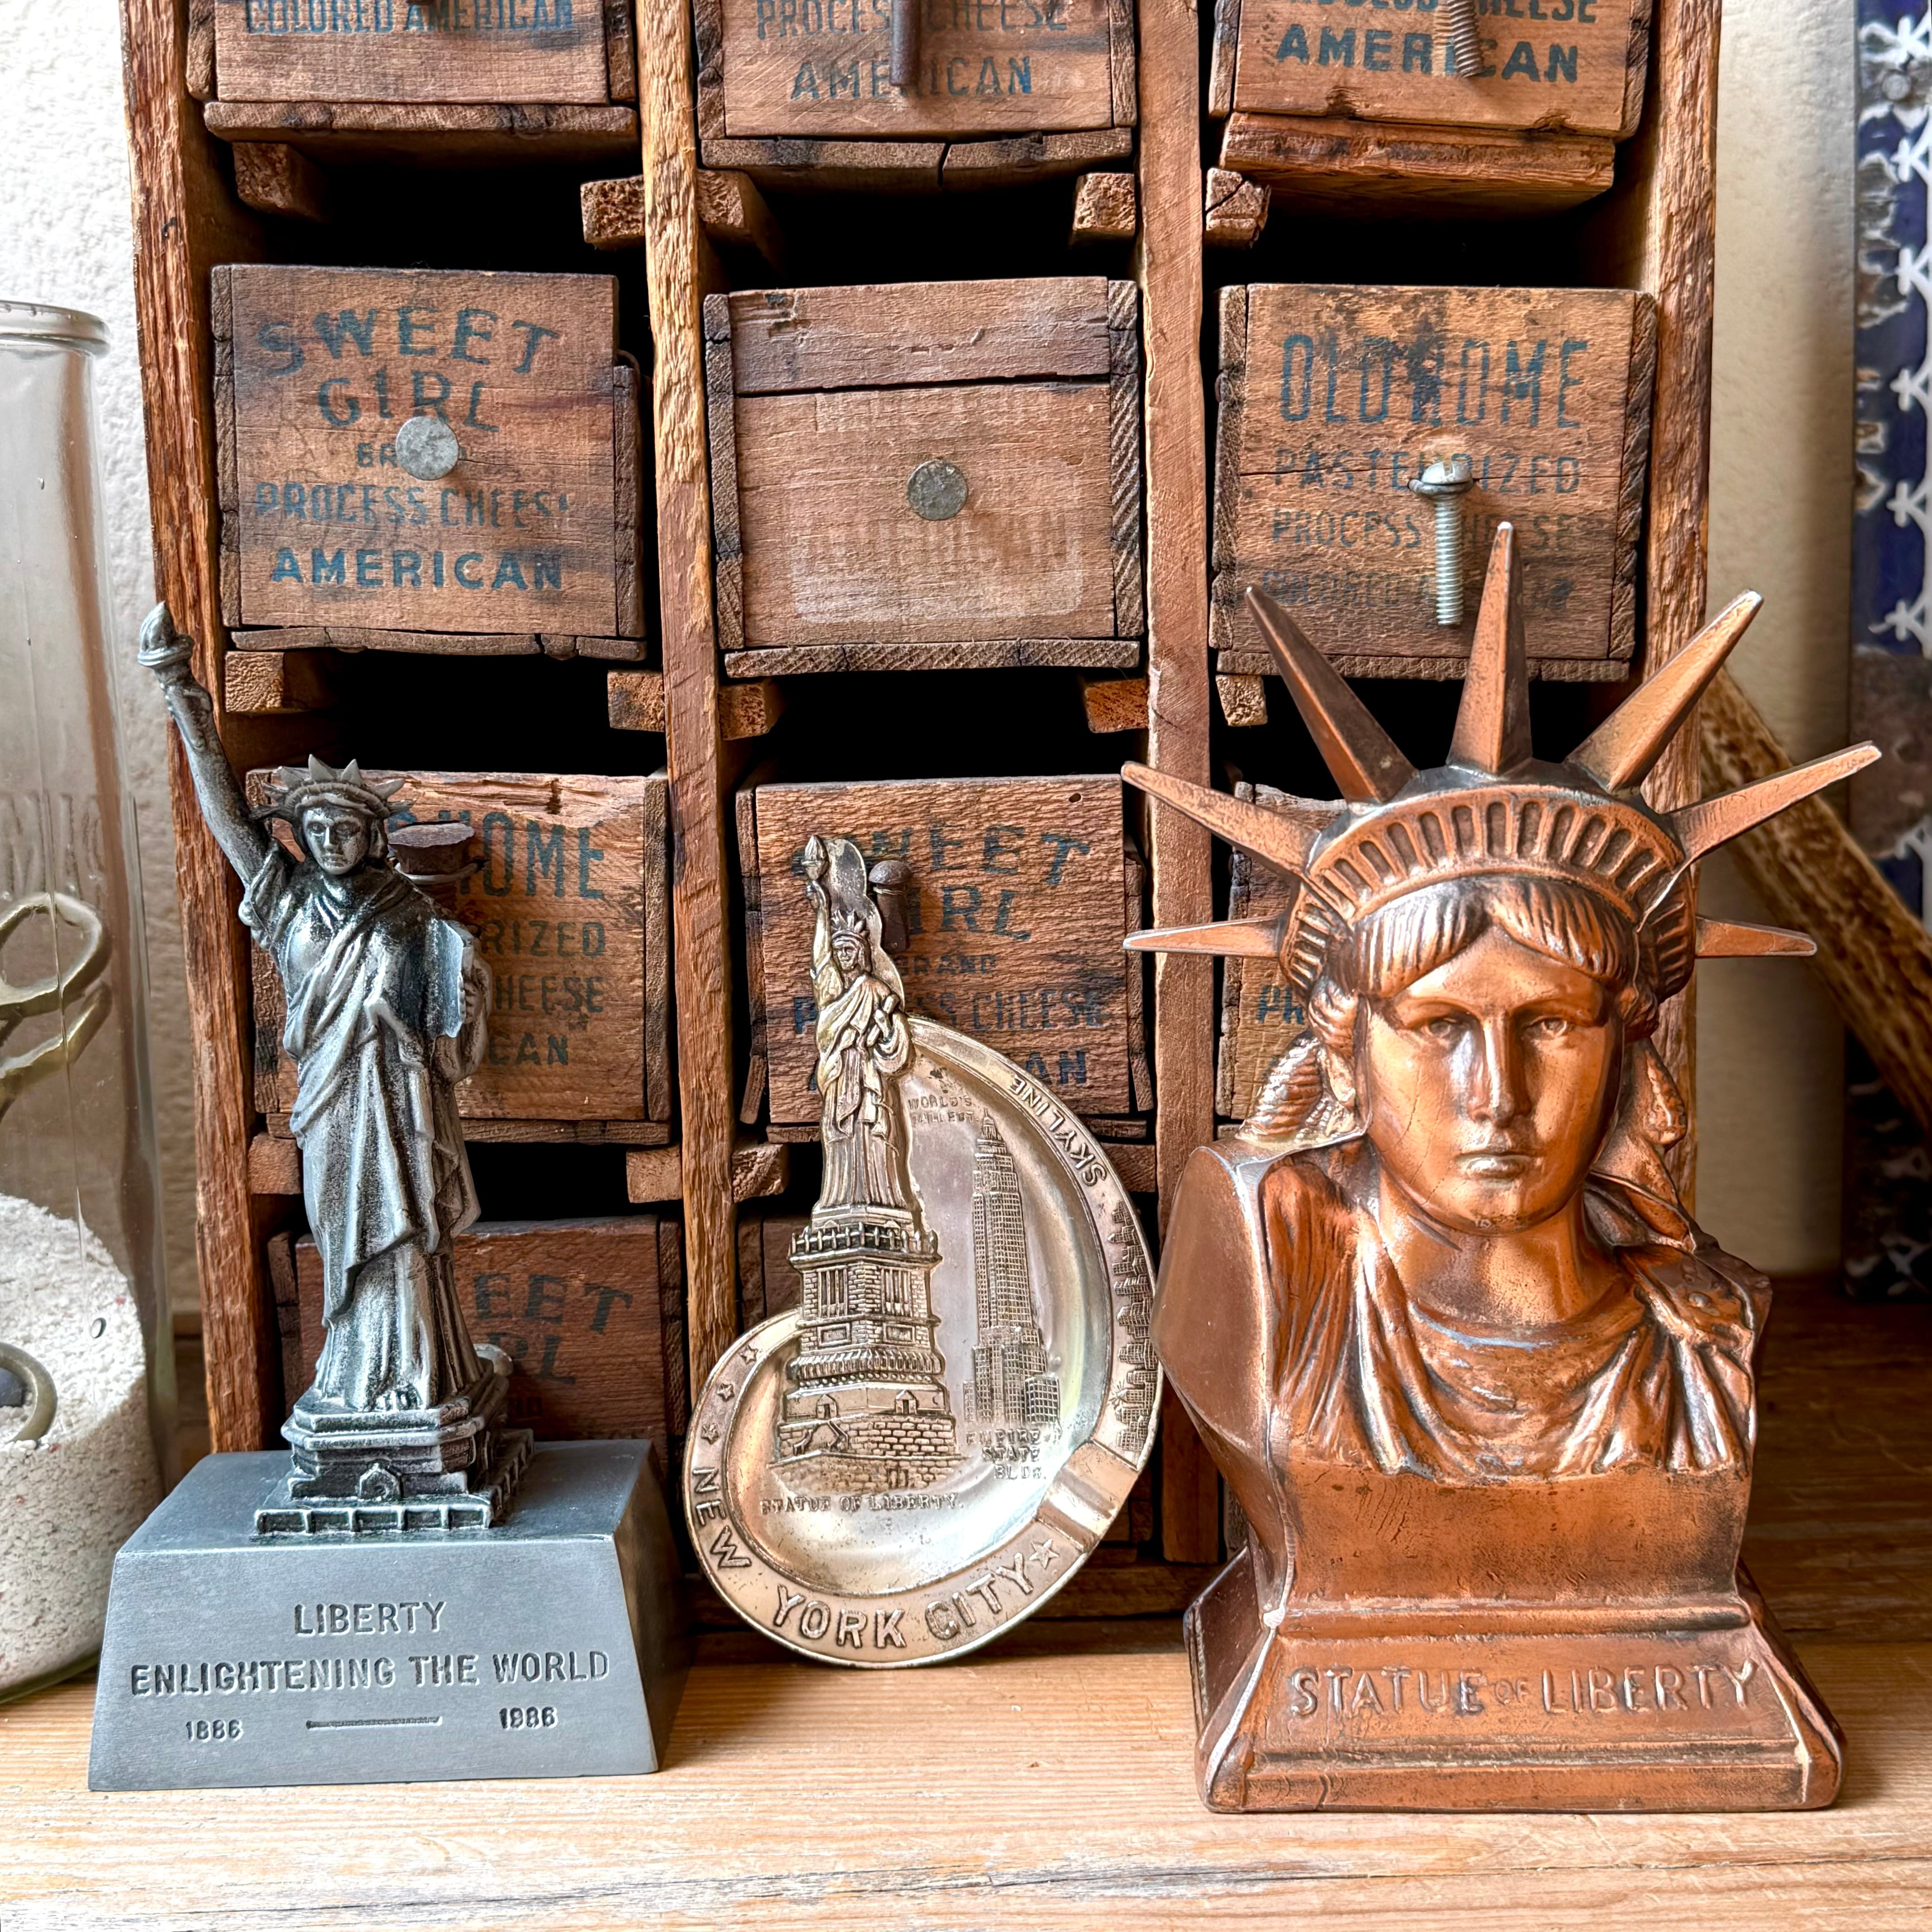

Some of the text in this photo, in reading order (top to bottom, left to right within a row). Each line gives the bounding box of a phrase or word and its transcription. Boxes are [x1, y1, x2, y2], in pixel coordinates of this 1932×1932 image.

[756, 0, 890, 40] PROCES
[791, 56, 1033, 101] AMEICAN
[256, 305, 560, 377] SWEET
[318, 369, 499, 433] GIRL
[1280, 333, 1588, 428] OLD HOME
[256, 481, 428, 526] PROCESS
[271, 546, 562, 591] AMERICAN
[907, 884, 1030, 941] IRL
[495, 975, 604, 1013] HEESE
[908, 1094, 972, 1110] WORLD'S
[1007, 1074, 1107, 1187] SKYLINE
[474, 1273, 633, 1334] EET
[965, 1428, 1041, 1445] EMPIRE
[982, 1445, 1040, 1462] STATE
[759, 1495, 832, 1515] STATUE
[840, 1494, 862, 1513] OF
[692, 1467, 1034, 1649] NEW YORK CITY
[294, 1601, 447, 1636] LIBERTY
[130, 1650, 612, 1696] ENLIGHTENING THE WORLD
[1290, 1659, 1760, 1717] STATUE OF LIBERTY
[185, 1706, 558, 1741] 1886 1986
